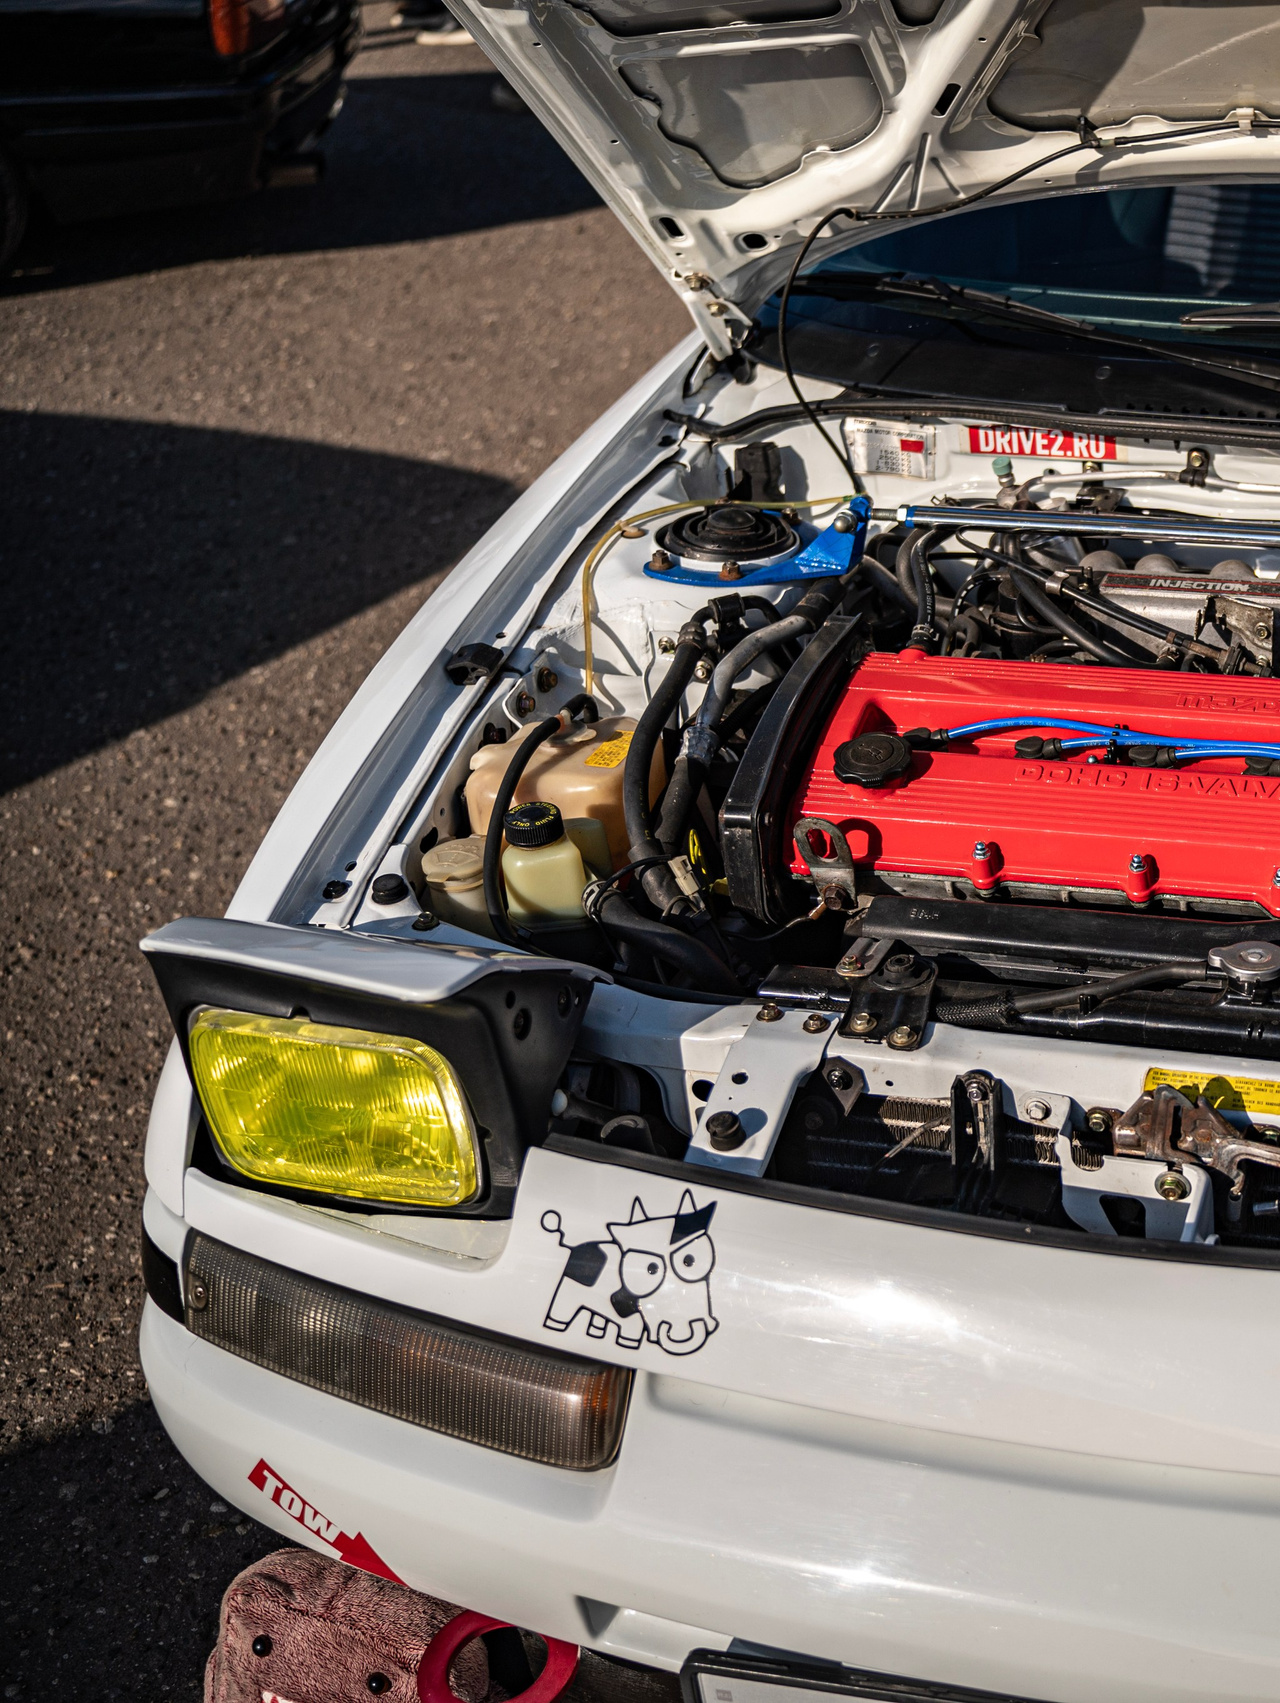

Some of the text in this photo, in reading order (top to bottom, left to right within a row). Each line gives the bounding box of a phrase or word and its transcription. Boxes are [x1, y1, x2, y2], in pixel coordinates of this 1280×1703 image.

[892, 431, 924, 440] CORPORATION
[978, 426, 1106, 458] DRIVE2.RU
[1149, 578, 1250, 592] INJECTION
[1014, 764, 1127, 789] DOHC
[509, 803, 531, 814] POWER
[535, 815, 554, 826] FLUID
[262, 1469, 341, 1543] TOW
